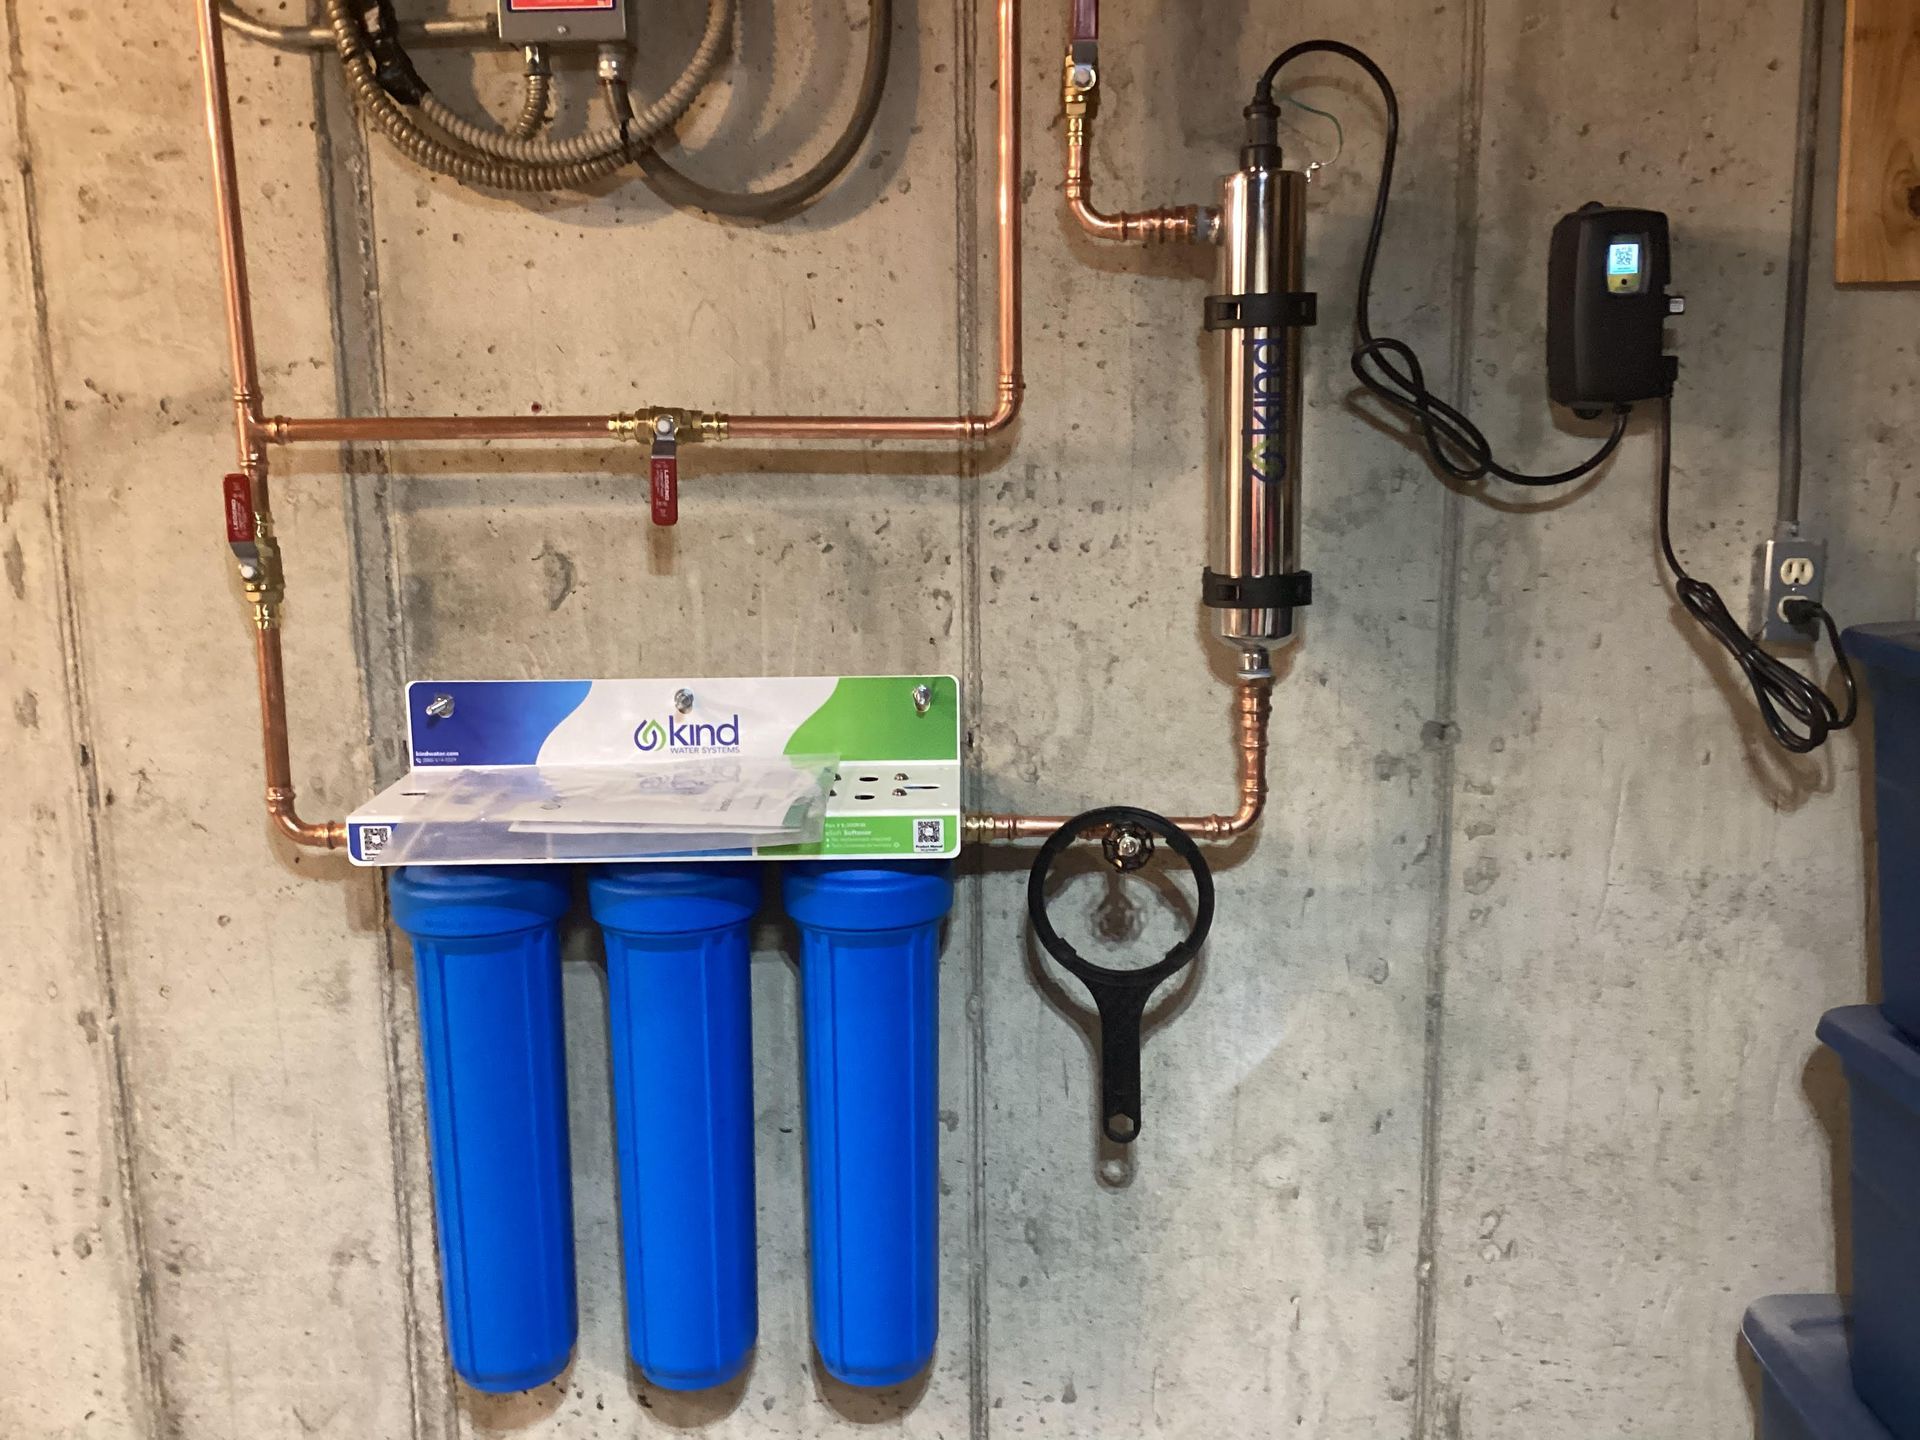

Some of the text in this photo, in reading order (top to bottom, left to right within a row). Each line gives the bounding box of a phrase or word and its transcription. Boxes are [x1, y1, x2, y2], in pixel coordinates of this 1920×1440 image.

[1242, 338, 1281, 434] kind
[231, 498, 239, 530] LEGEND
[669, 714, 739, 746] kind
[702, 746, 740, 754] SYSTEMS
